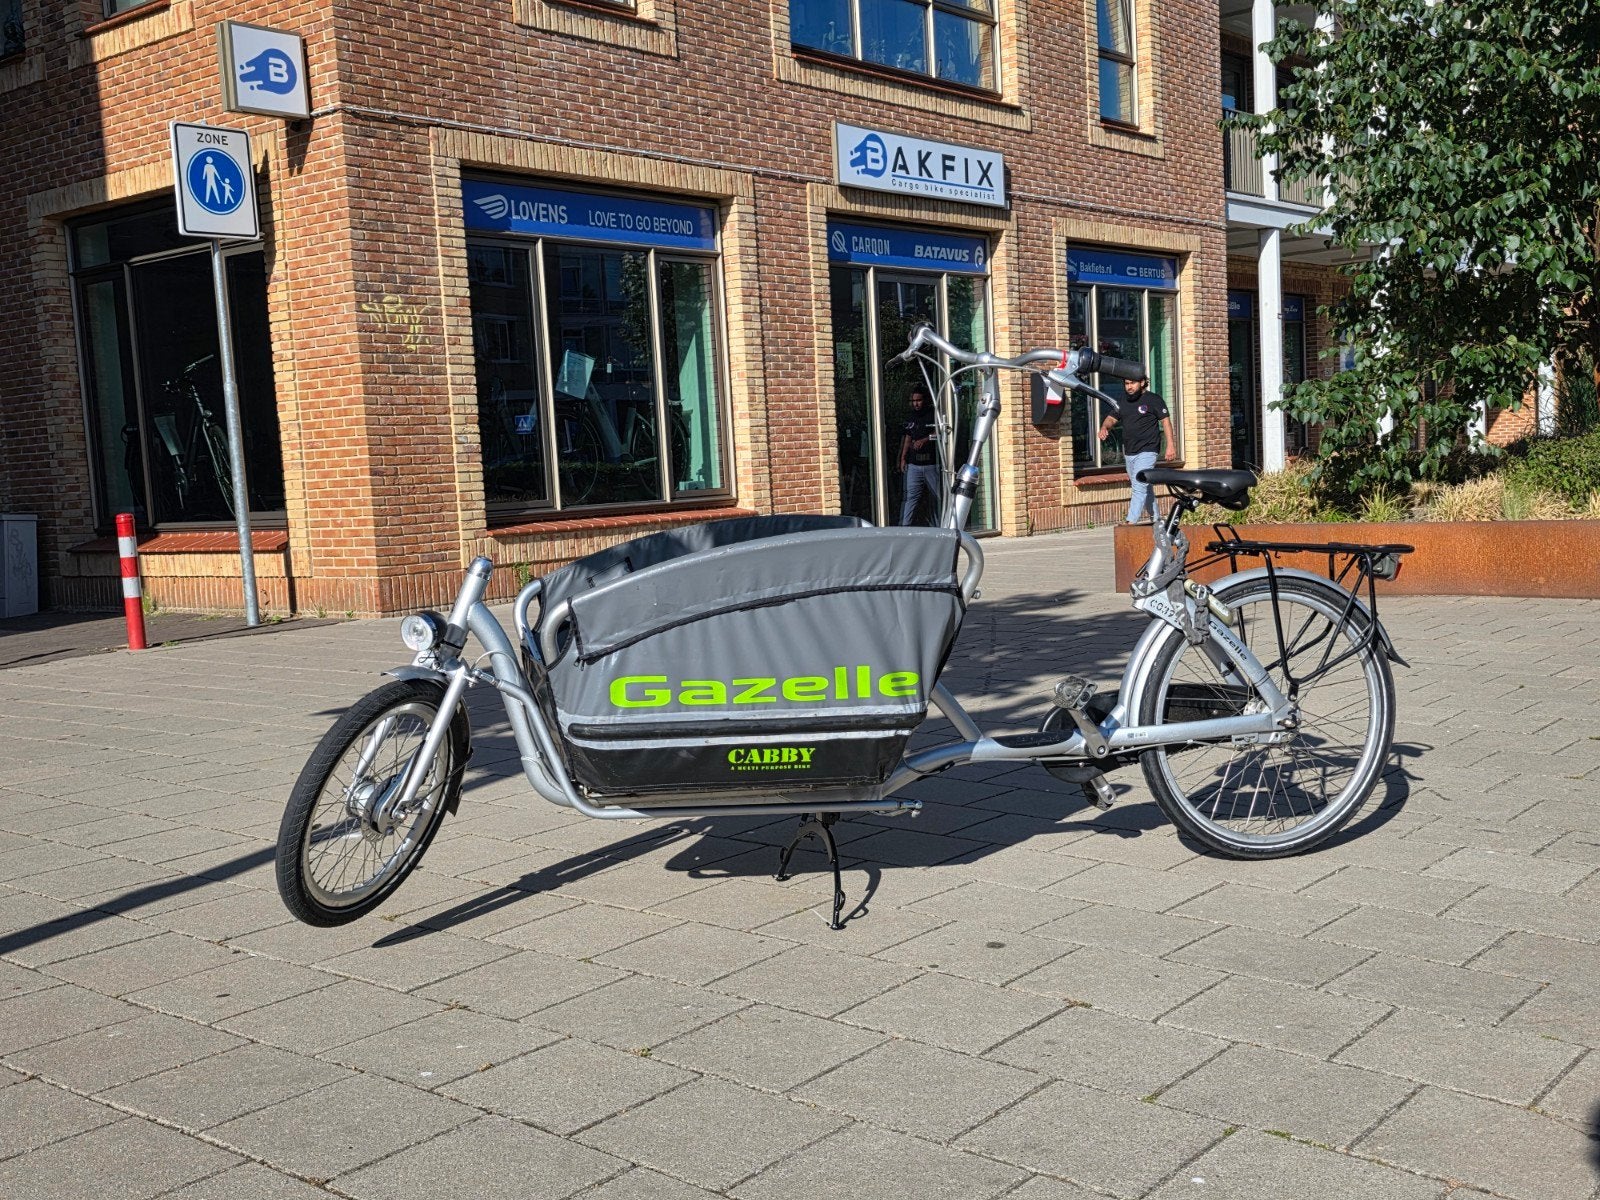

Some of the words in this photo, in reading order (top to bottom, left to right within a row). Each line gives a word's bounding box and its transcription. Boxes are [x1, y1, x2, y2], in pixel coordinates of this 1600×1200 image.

[268, 57, 289, 83] B
[196, 132, 229, 146] ZONE
[866, 140, 994, 188] BAKFIX
[891, 179, 920, 191] Cargo
[924, 184, 944, 194] bike
[949, 188, 995, 201] specialist
[510, 199, 568, 225] LOVENS
[588, 210, 616, 229] LOVE
[618, 213, 633, 230] TO
[635, 216, 651, 231] GO
[653, 218, 693, 235] BEYOND
[851, 236, 890, 257] CARQON
[914, 245, 970, 262] BATAVUS
[1079, 261, 1113, 275] Bakfiets.nl
[1139, 268, 1166, 279] BERTUS
[1209, 620, 1248, 661] Gazelle
[609, 665, 921, 708] Gazelle
[727, 747, 816, 764] CABBY
